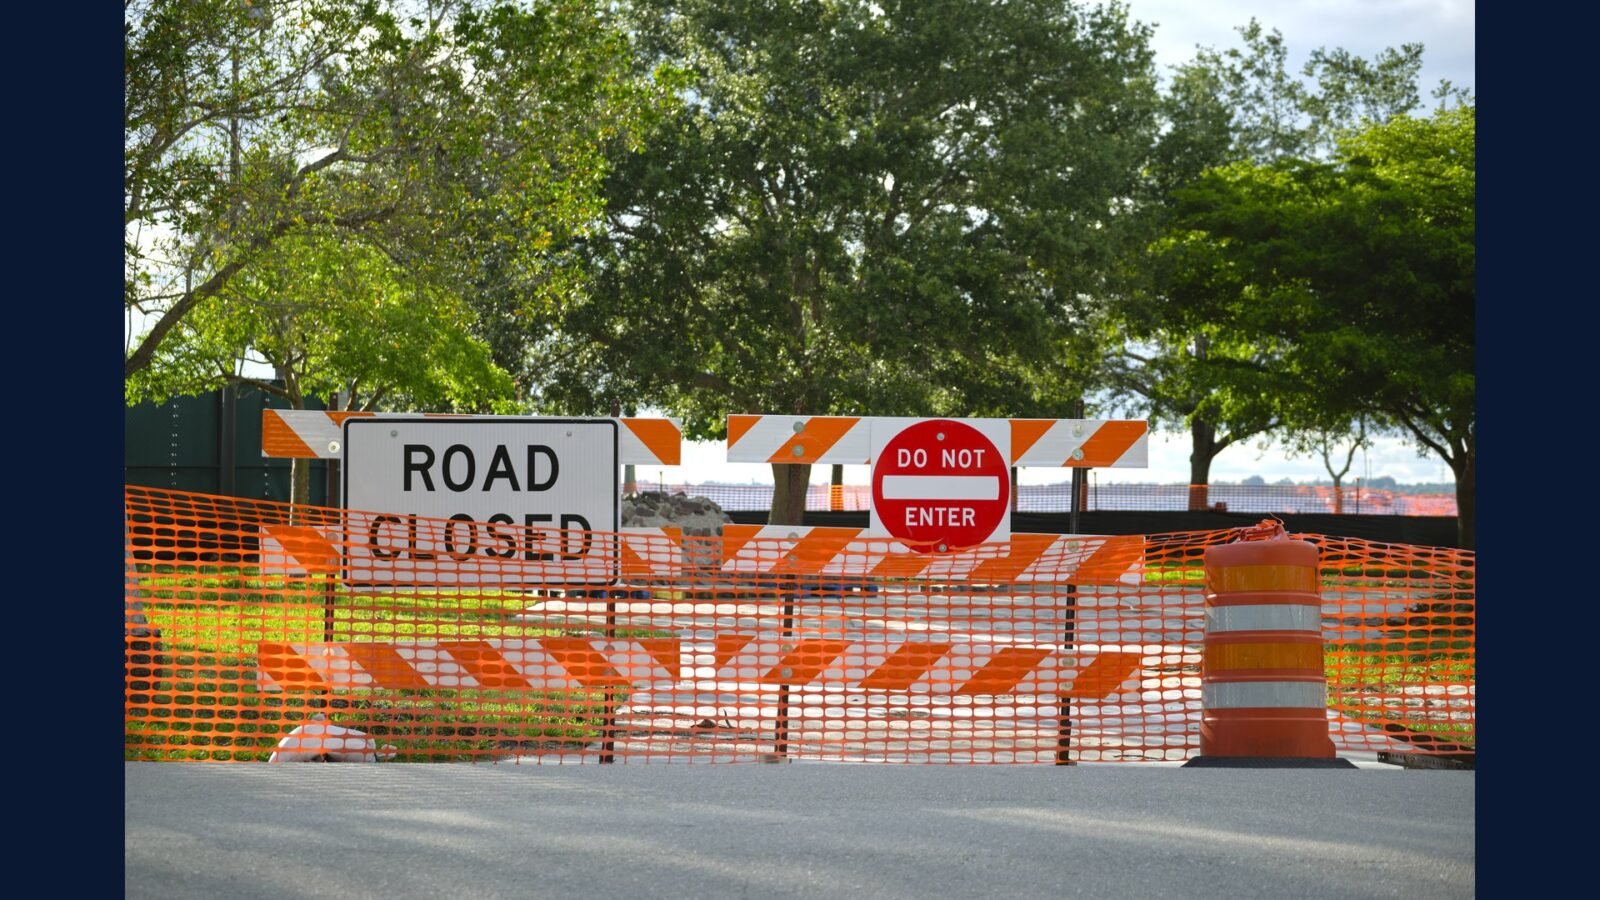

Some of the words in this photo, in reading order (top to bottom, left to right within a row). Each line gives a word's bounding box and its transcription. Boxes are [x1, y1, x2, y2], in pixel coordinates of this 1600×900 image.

[403, 444, 559, 492] ROAD
[897, 448, 928, 468] DO
[941, 448, 985, 469] NOT
[905, 507, 976, 527] ENTER
[369, 513, 593, 561] CLOSED
